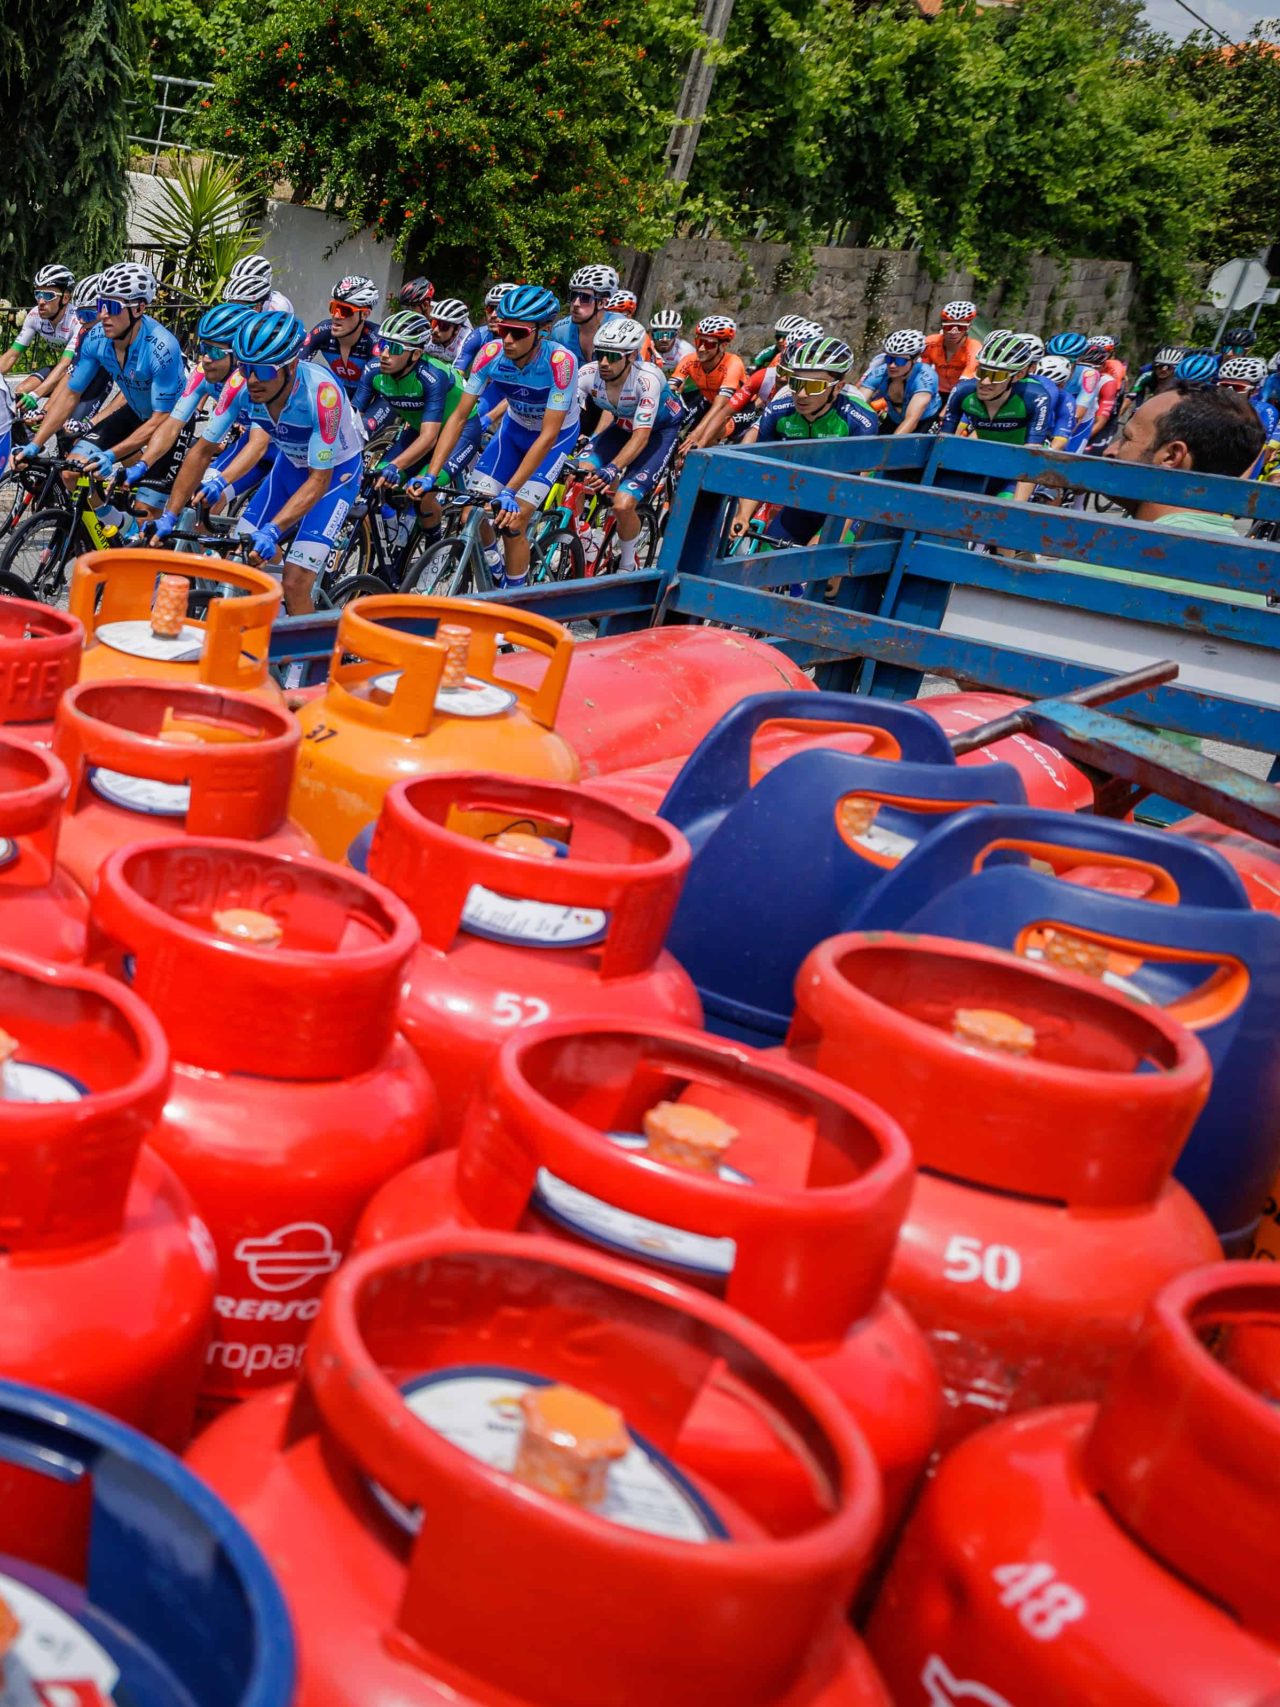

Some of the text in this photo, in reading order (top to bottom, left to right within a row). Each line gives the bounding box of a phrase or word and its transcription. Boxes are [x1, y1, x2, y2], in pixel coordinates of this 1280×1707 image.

[336, 366, 356, 377] RP
[850, 409, 872, 428] CORTIZO
[305, 724, 339, 744] 37
[942, 1234, 1022, 1293] 50
[213, 1294, 322, 1322] REPSO
[991, 1559, 1088, 1642] 48
